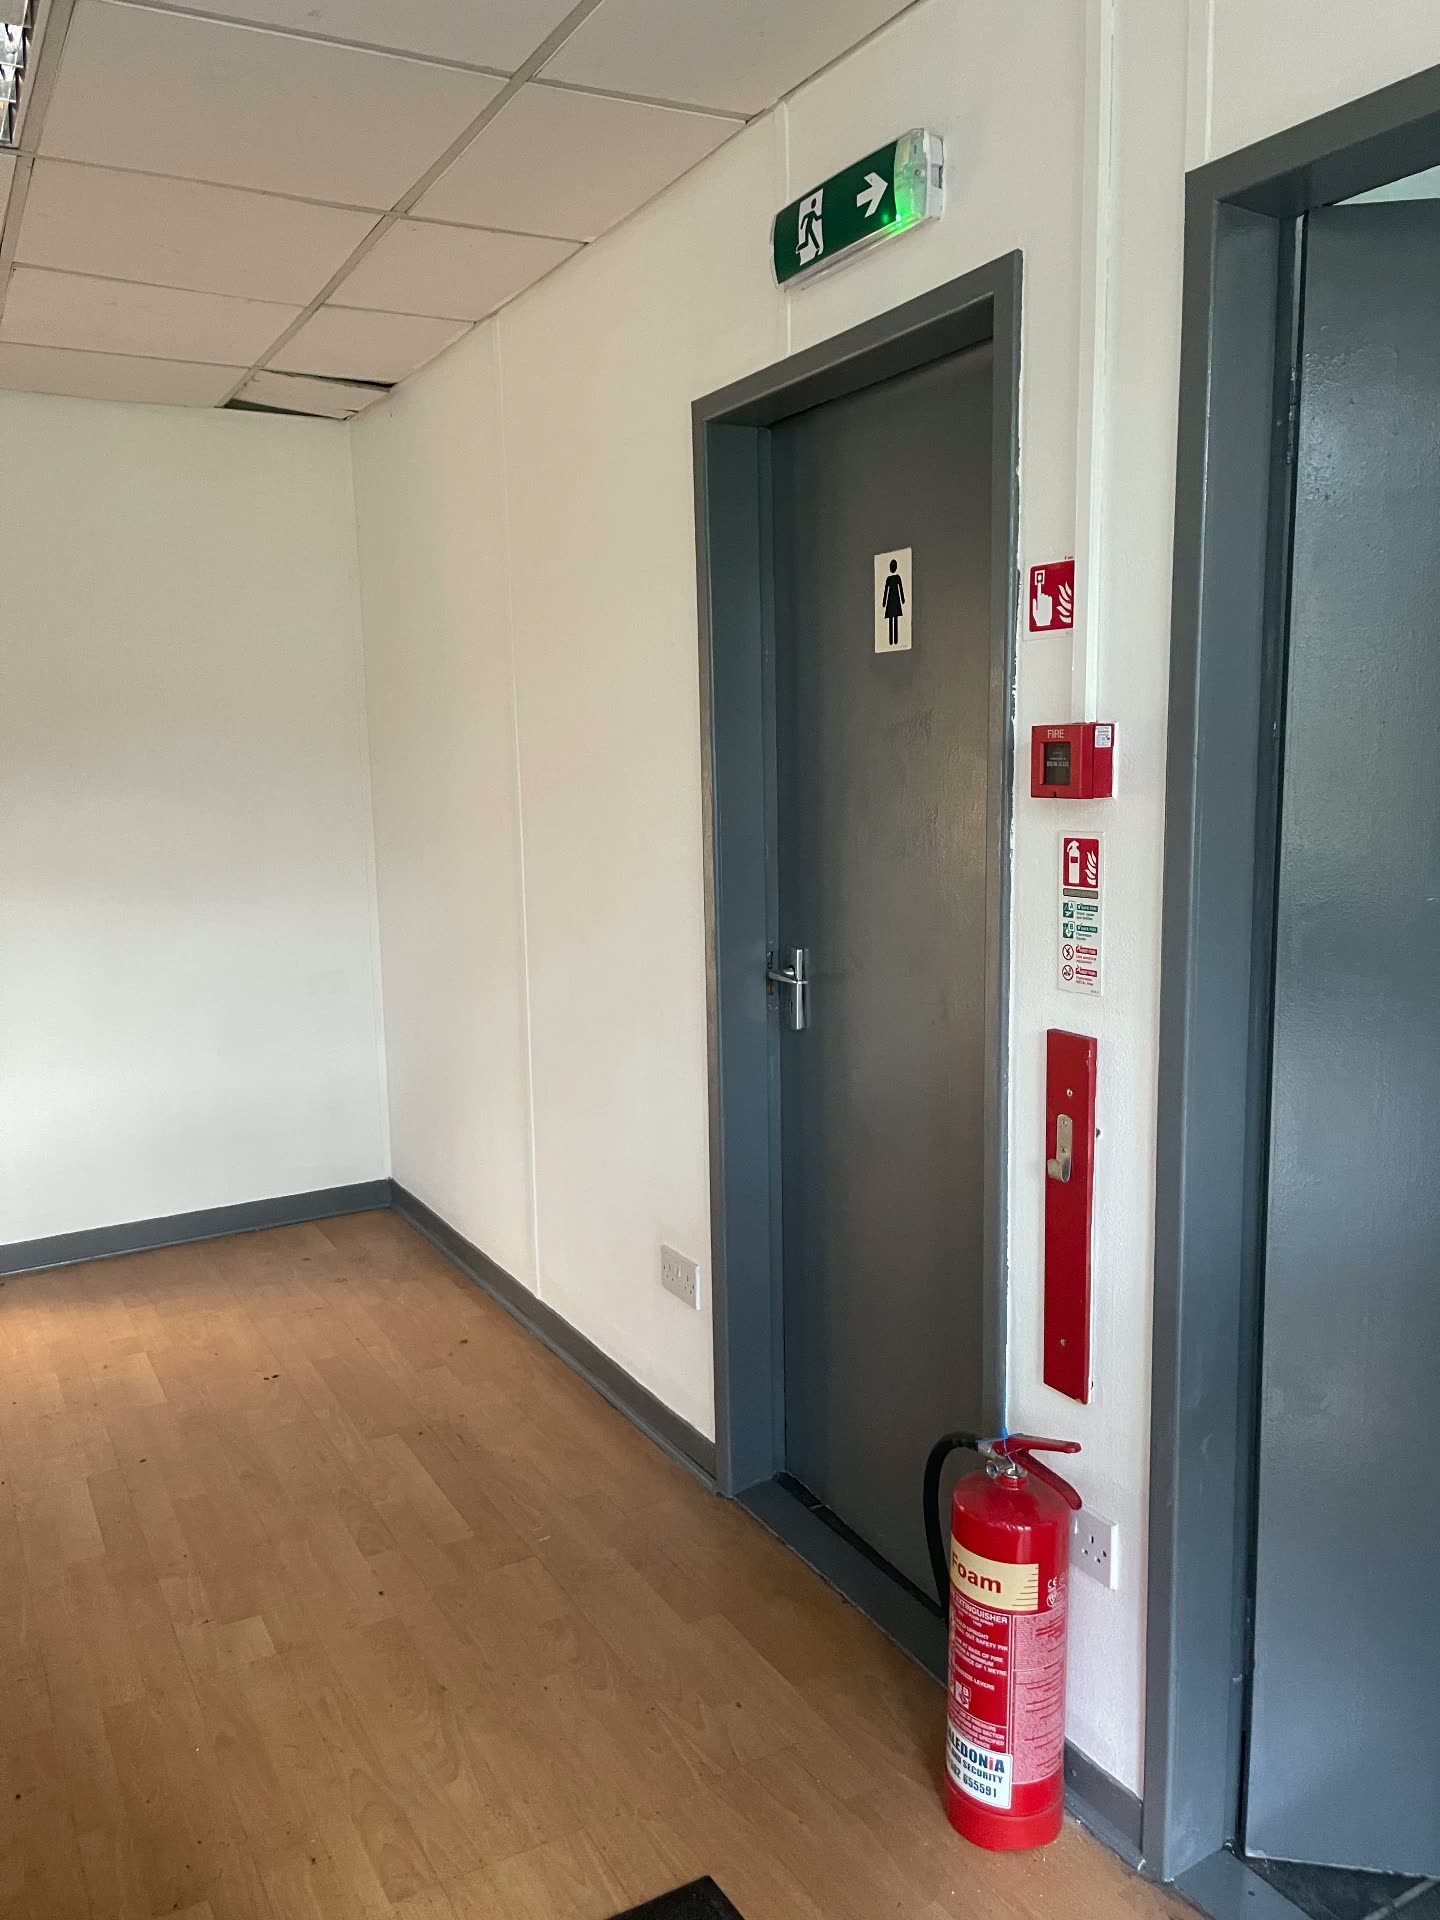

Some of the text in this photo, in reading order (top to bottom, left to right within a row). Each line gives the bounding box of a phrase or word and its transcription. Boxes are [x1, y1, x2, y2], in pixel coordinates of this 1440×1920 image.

[1048, 729, 1065, 739] FIRE
[951, 1551, 1002, 1594] Foam
[975, 1638, 996, 1649] SAFETY
[997, 1644, 1008, 1652] PIN
[962, 1759, 1003, 1784] SECURITY
[963, 1774, 997, 1798] 655591
